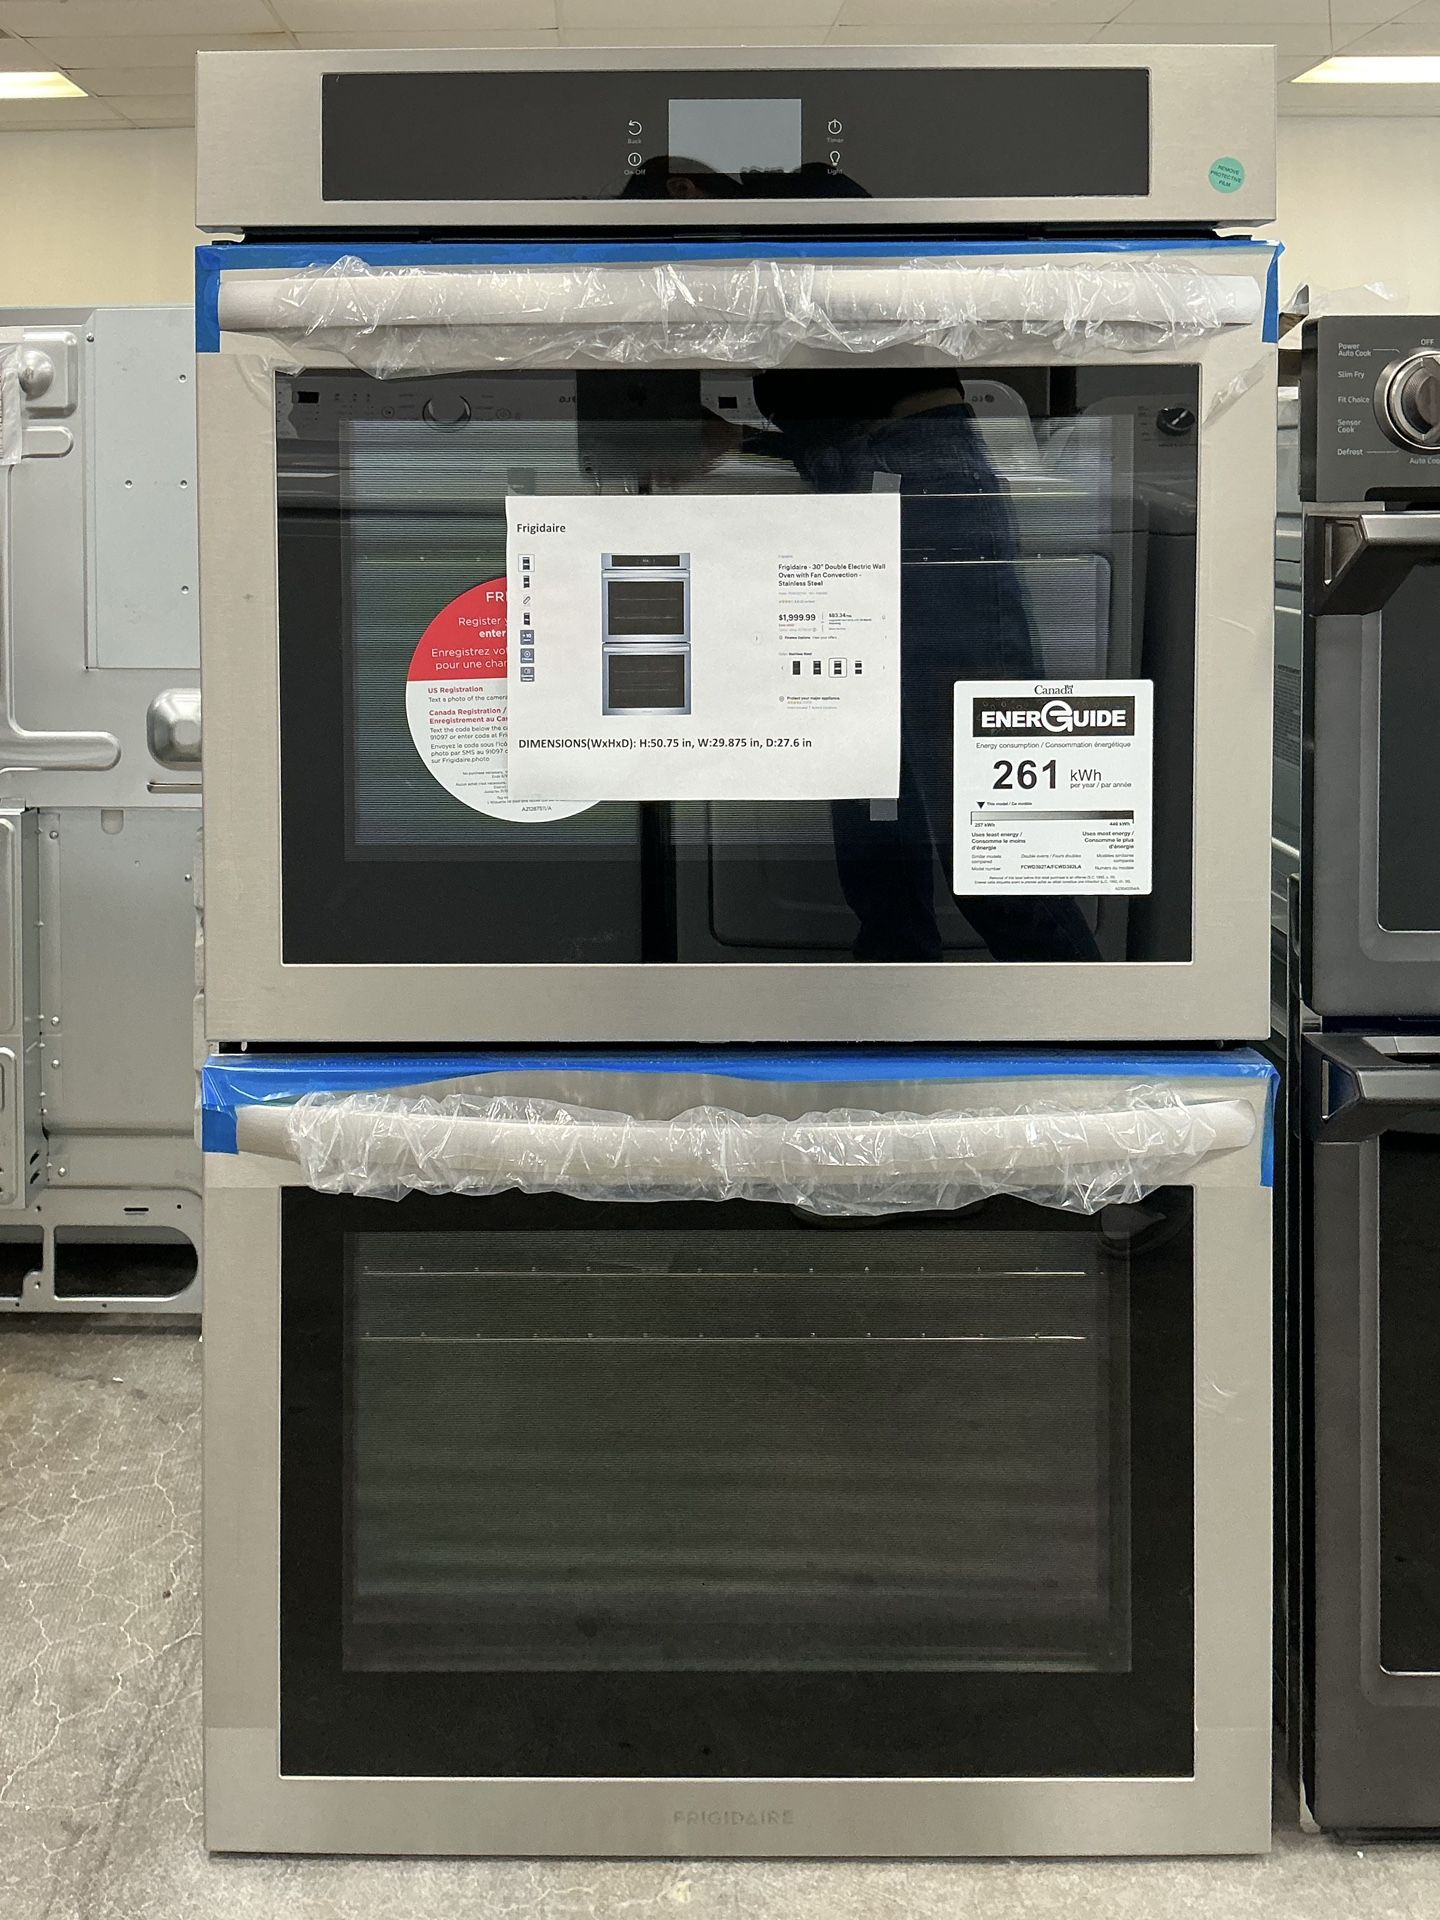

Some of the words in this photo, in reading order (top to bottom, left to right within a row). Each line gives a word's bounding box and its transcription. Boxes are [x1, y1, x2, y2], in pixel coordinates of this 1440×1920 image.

[1218, 165, 1239, 175] REMOVE
[1354, 371, 1365, 379] Fry
[516, 523, 566, 535] Frigidaire
[458, 617, 501, 627] Register
[778, 614, 816, 622] $1,999.99
[479, 629, 506, 638] enter
[431, 648, 490, 658] Enregistrez
[435, 662, 460, 671] pour
[440, 686, 483, 694] Registration
[1034, 684, 1073, 695] Canada
[981, 700, 1126, 732] ENERGUIDE
[518, 738, 636, 750] DIMENSIONS(WxHxD):
[639, 739, 679, 748] H:50.75
[682, 738, 695, 749] in,
[698, 738, 747, 748] W:29.875
[750, 738, 763, 749] in,
[766, 738, 800, 747] D:27.6
[802, 738, 812, 747] in
[992, 759, 1057, 790] 261
[1070, 769, 1101, 781] kWh
[673, 1809, 795, 1826] FRIGIDAIRE
